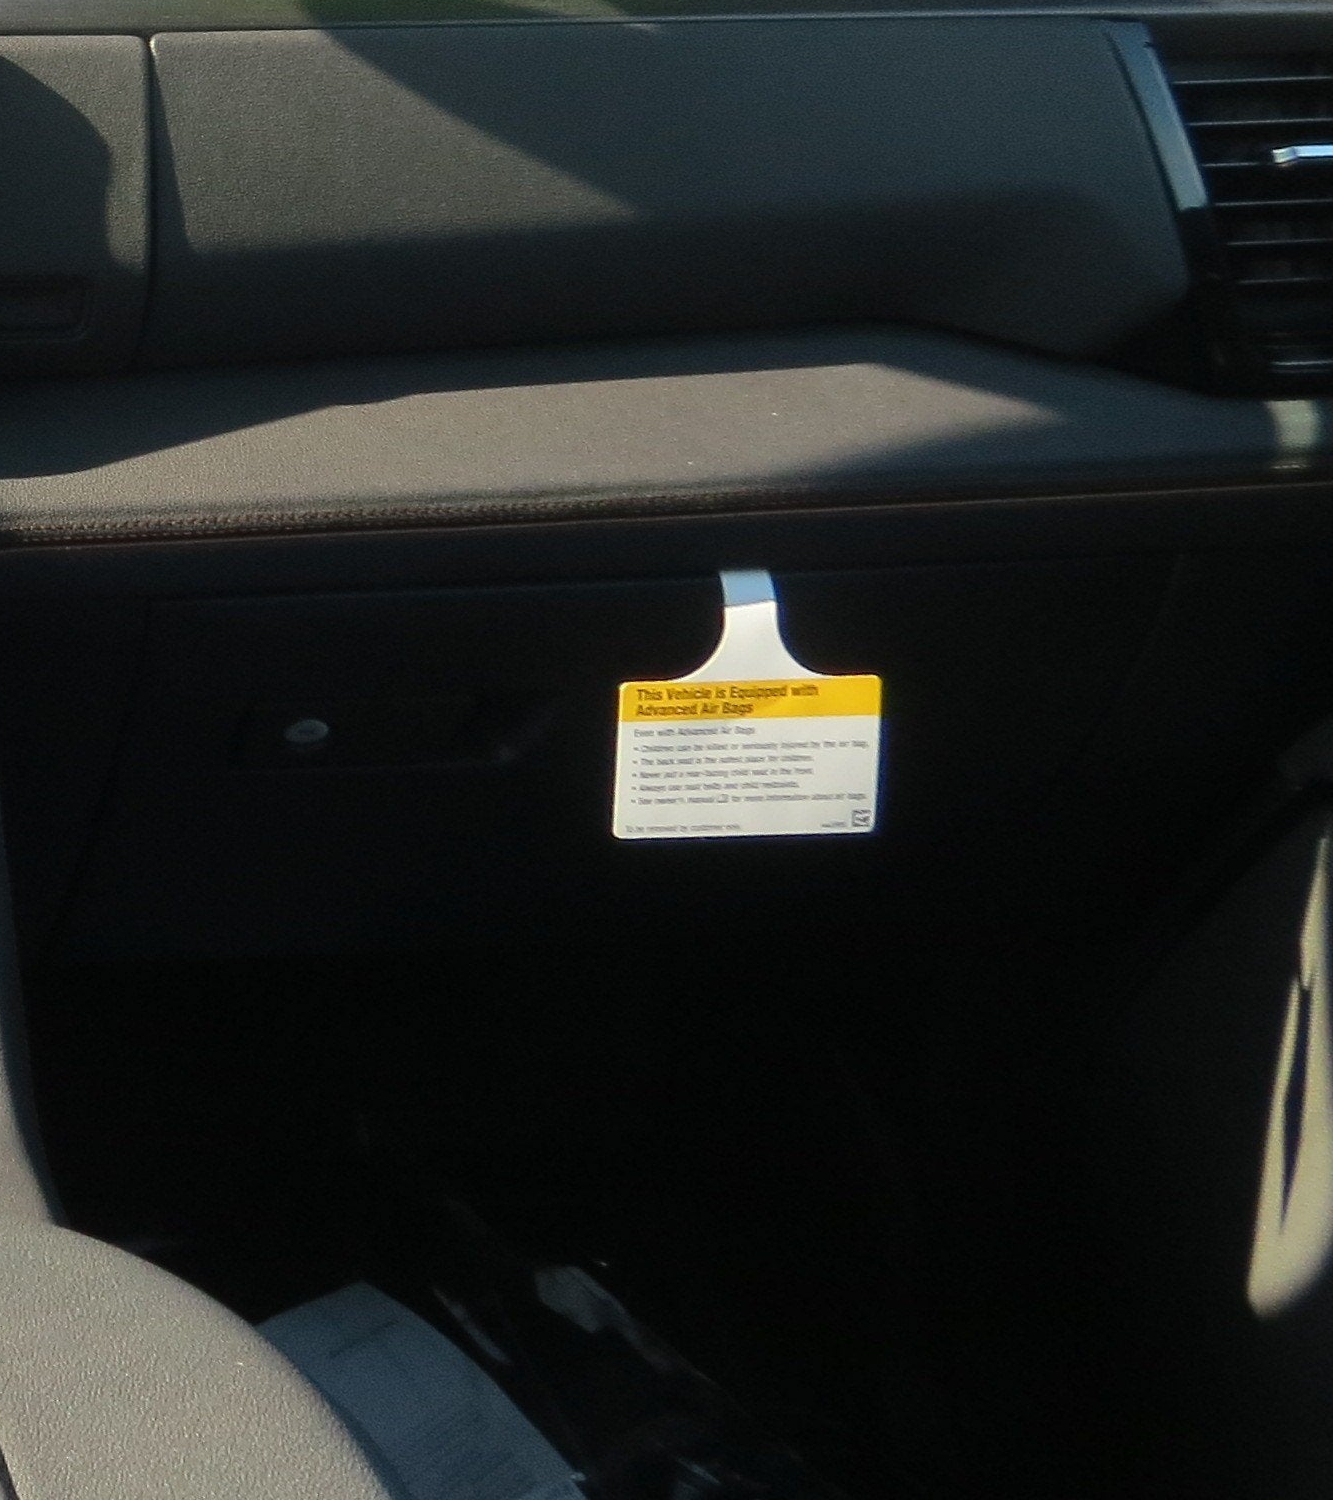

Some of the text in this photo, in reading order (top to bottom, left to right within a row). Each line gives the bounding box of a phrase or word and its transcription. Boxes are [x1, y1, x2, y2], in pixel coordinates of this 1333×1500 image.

[636, 684, 820, 701] This Vehicle is Equipped with
[636, 702, 755, 717] Advanced Air Bags
